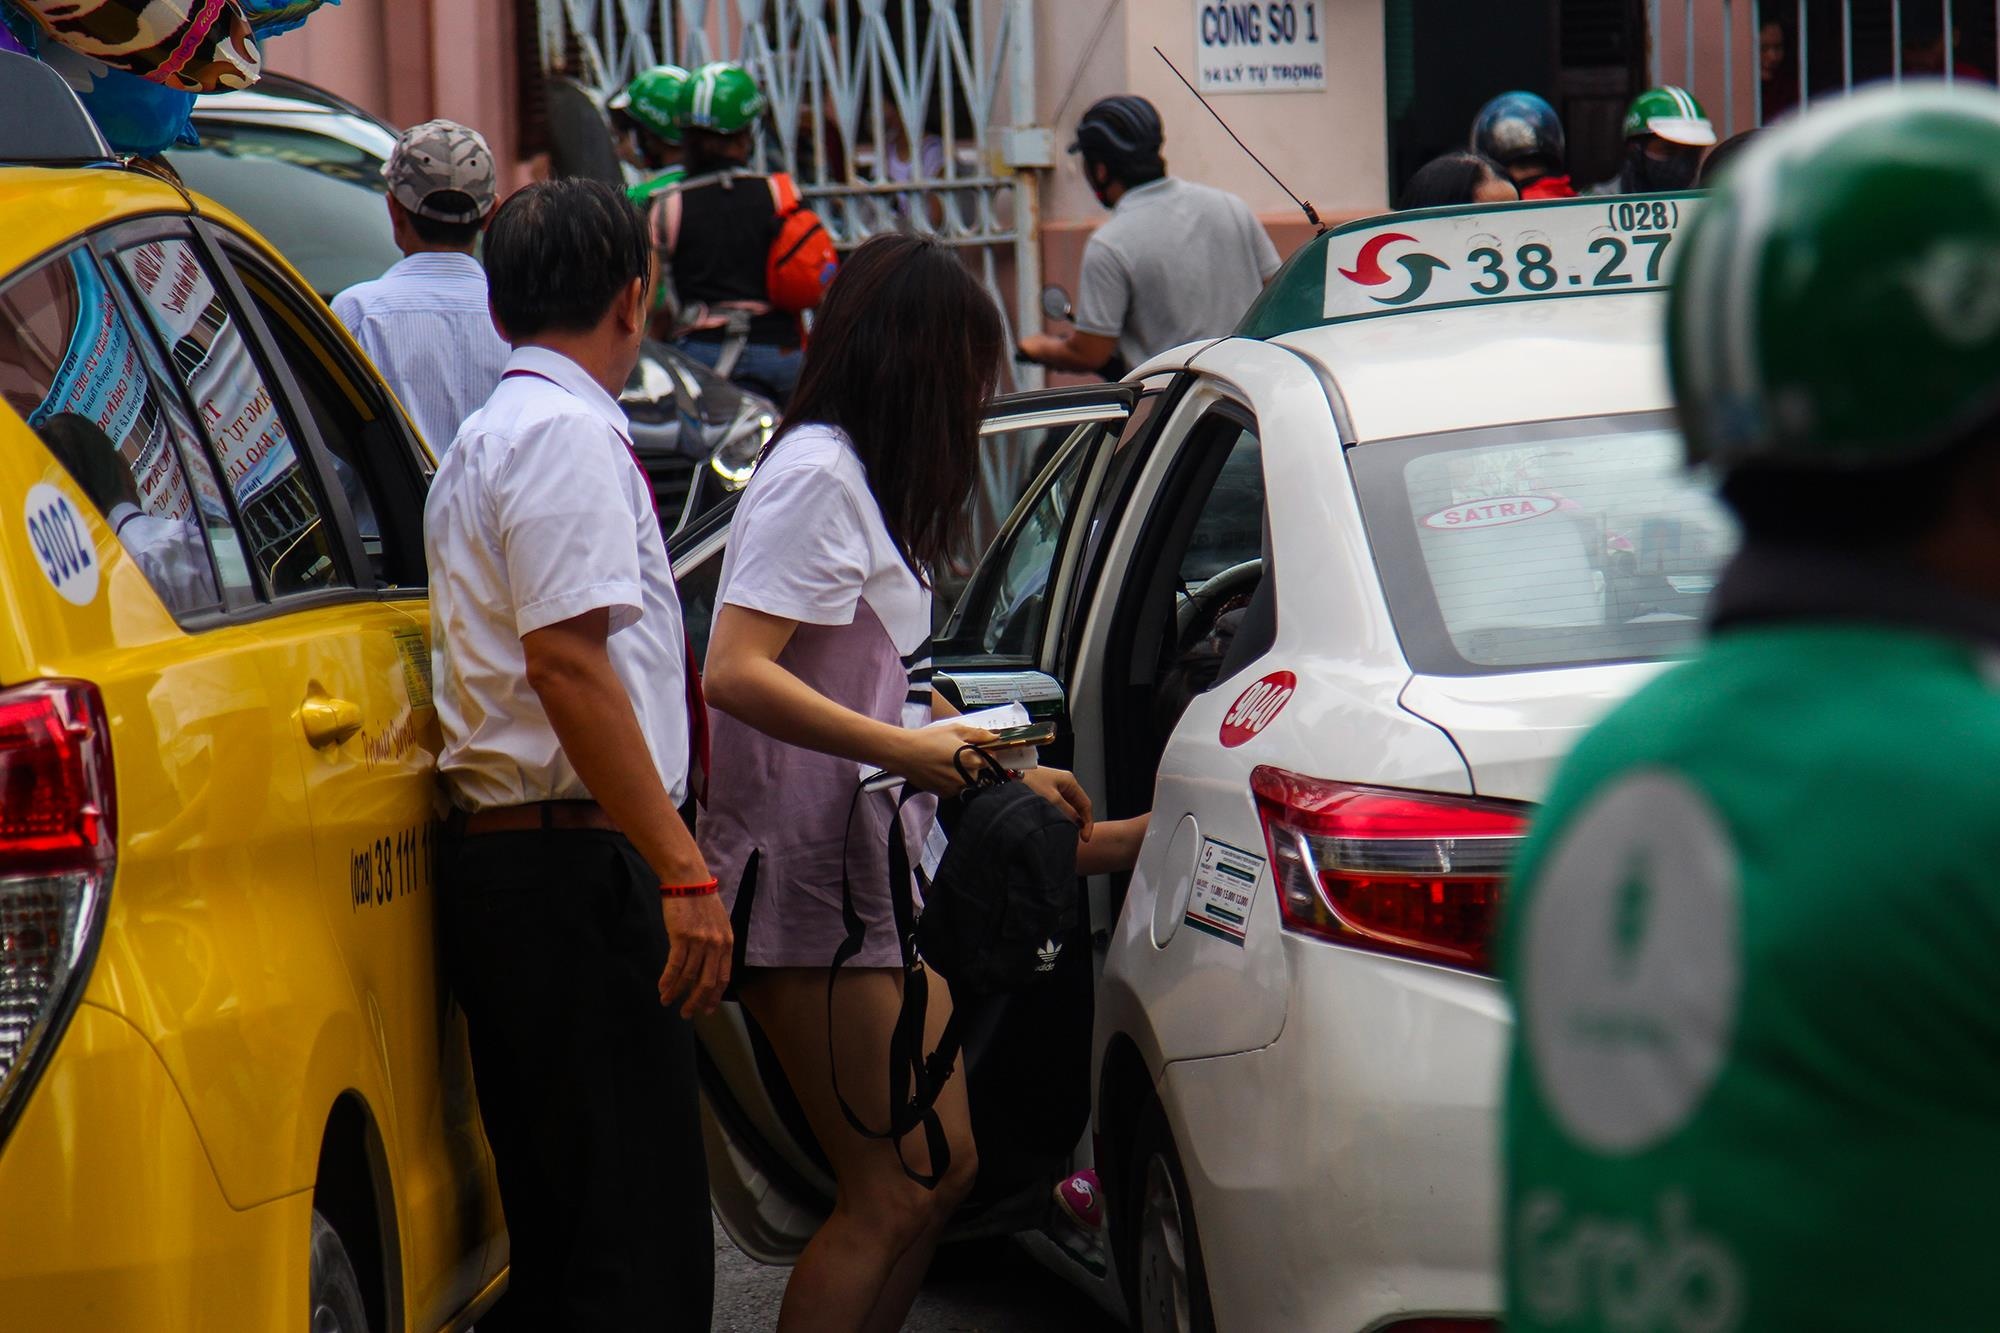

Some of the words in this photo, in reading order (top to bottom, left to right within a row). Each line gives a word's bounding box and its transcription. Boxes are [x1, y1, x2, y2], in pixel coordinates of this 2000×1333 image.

[1305, 3, 1319, 43] 1
[1609, 201, 1679, 232] (028)
[1444, 501, 1537, 525] SATRA
[28, 497, 91, 587] 9002
[1225, 681, 1292, 732] 9040
[350, 844, 373, 914] (028)
[375, 836, 393, 906] 38
[396, 826, 417, 897] 111
